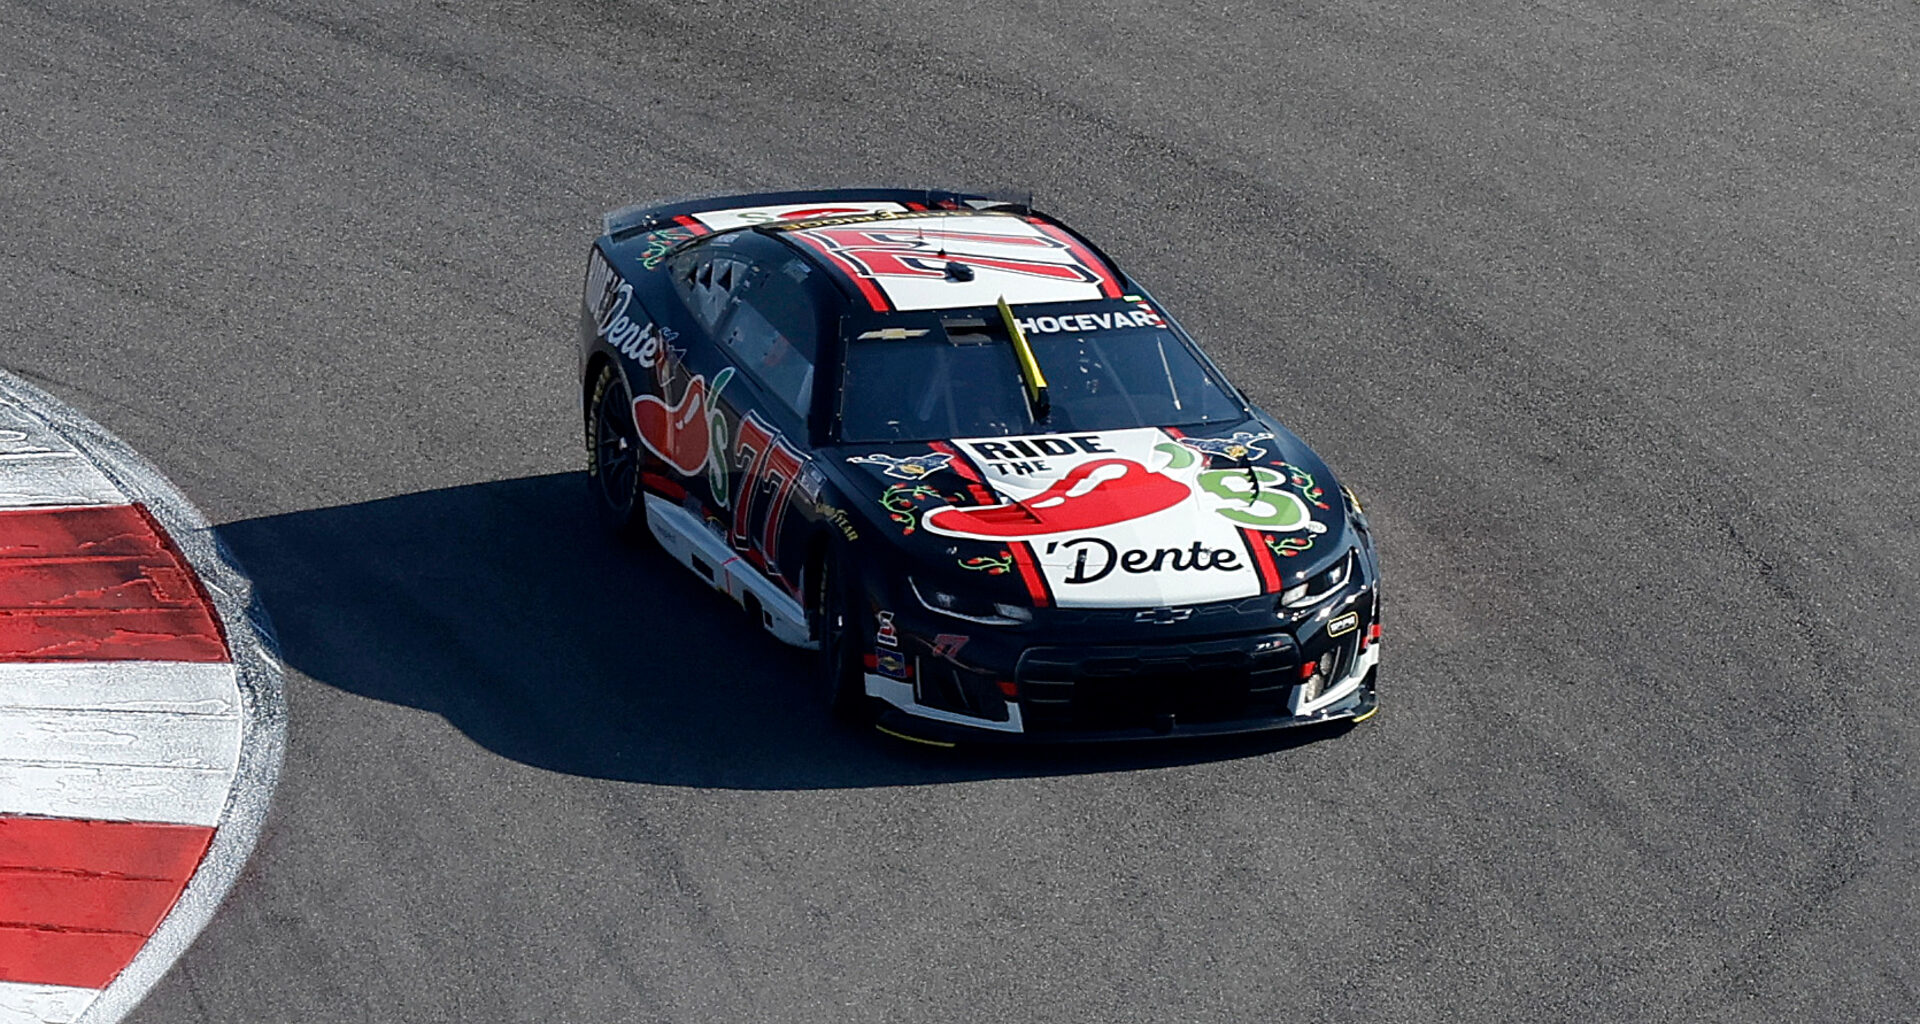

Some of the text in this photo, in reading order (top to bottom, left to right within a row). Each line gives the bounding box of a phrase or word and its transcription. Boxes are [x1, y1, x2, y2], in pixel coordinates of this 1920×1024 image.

[1013, 310, 1155, 334] HOCEVAR
[968, 436, 1117, 460] RIDE
[988, 460, 1052, 476] THE
[733, 409, 812, 576] 77
[1046, 537, 1244, 584] 'Dente
